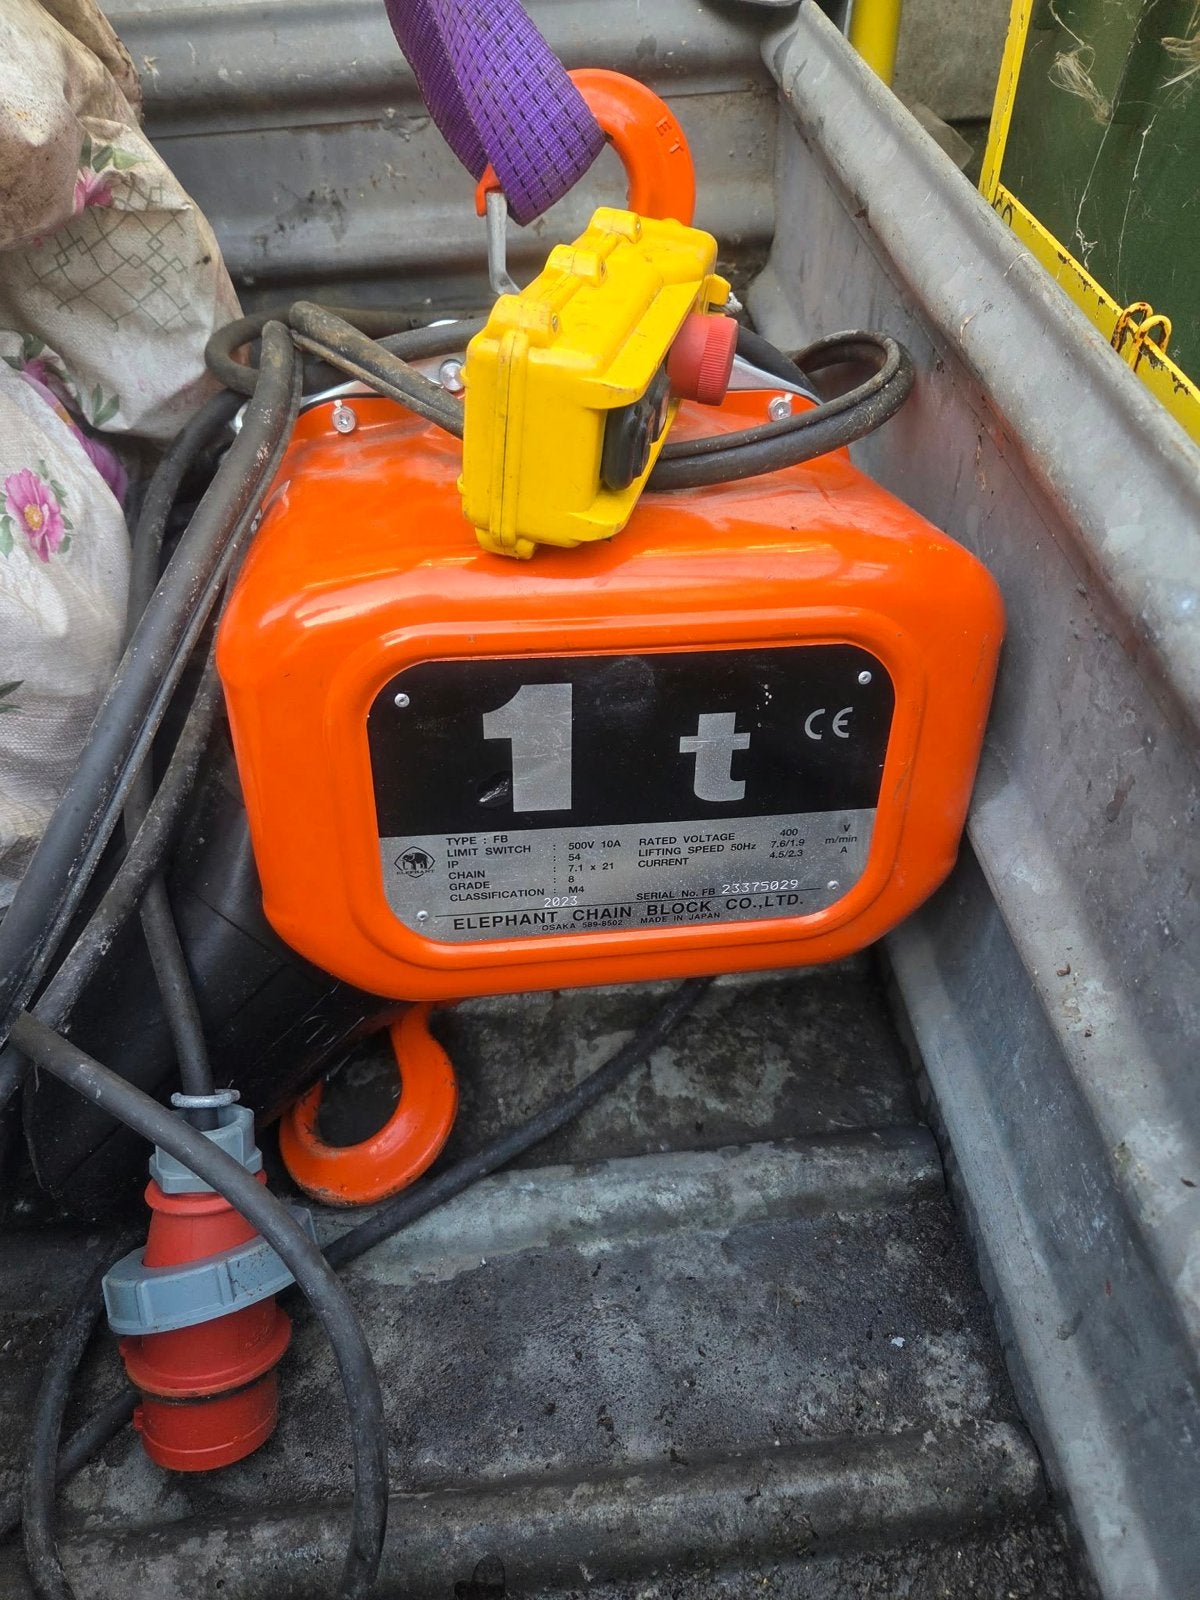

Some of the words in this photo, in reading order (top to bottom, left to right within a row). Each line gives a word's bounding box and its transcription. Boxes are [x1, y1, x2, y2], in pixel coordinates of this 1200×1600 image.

[804, 706, 854, 740] CE
[482, 683, 573, 813] 1
[679, 712, 750, 802] t
[446, 836, 477, 846] TYPE
[493, 835, 509, 843] FB
[639, 836, 677, 846] RATED
[683, 833, 736, 843] VOLTAGE
[780, 828, 798, 836] 400
[843, 824, 851, 832] V
[447, 848, 479, 857] LIMIT
[485, 845, 531, 856] SWITCH
[568, 841, 595, 850] 500V
[601, 840, 621, 848] 10A
[638, 847, 681, 857] LIFTING
[687, 844, 725, 854] SPEED
[730, 842, 757, 852] 50Hz
[771, 838, 805, 848] 7.6/1.9
[825, 835, 858, 844] m/min
[568, 853, 581, 861] 54
[638, 857, 689, 868] CURRENT
[769, 849, 803, 859] 4.5/2.3
[448, 870, 486, 880] CHAIN
[568, 864, 583, 872] 7.1
[602, 862, 614, 870] 21
[449, 881, 490, 891] GRADE
[449, 888, 545, 902] CLASSIFICATION
[636, 891, 675, 901] SERIAL
[702, 888, 716, 896] FB
[721, 879, 799, 894] 23375029
[544, 896, 578, 908] 2023
[453, 911, 558, 930] ELEPHANT
[572, 906, 632, 921] CHAIN
[647, 901, 711, 916] BLOCK
[541, 922, 576, 931] OSAKA
[582, 920, 623, 928] 589-8502
[640, 915, 668, 924] MADE
[689, 912, 720, 920] JAPAN
